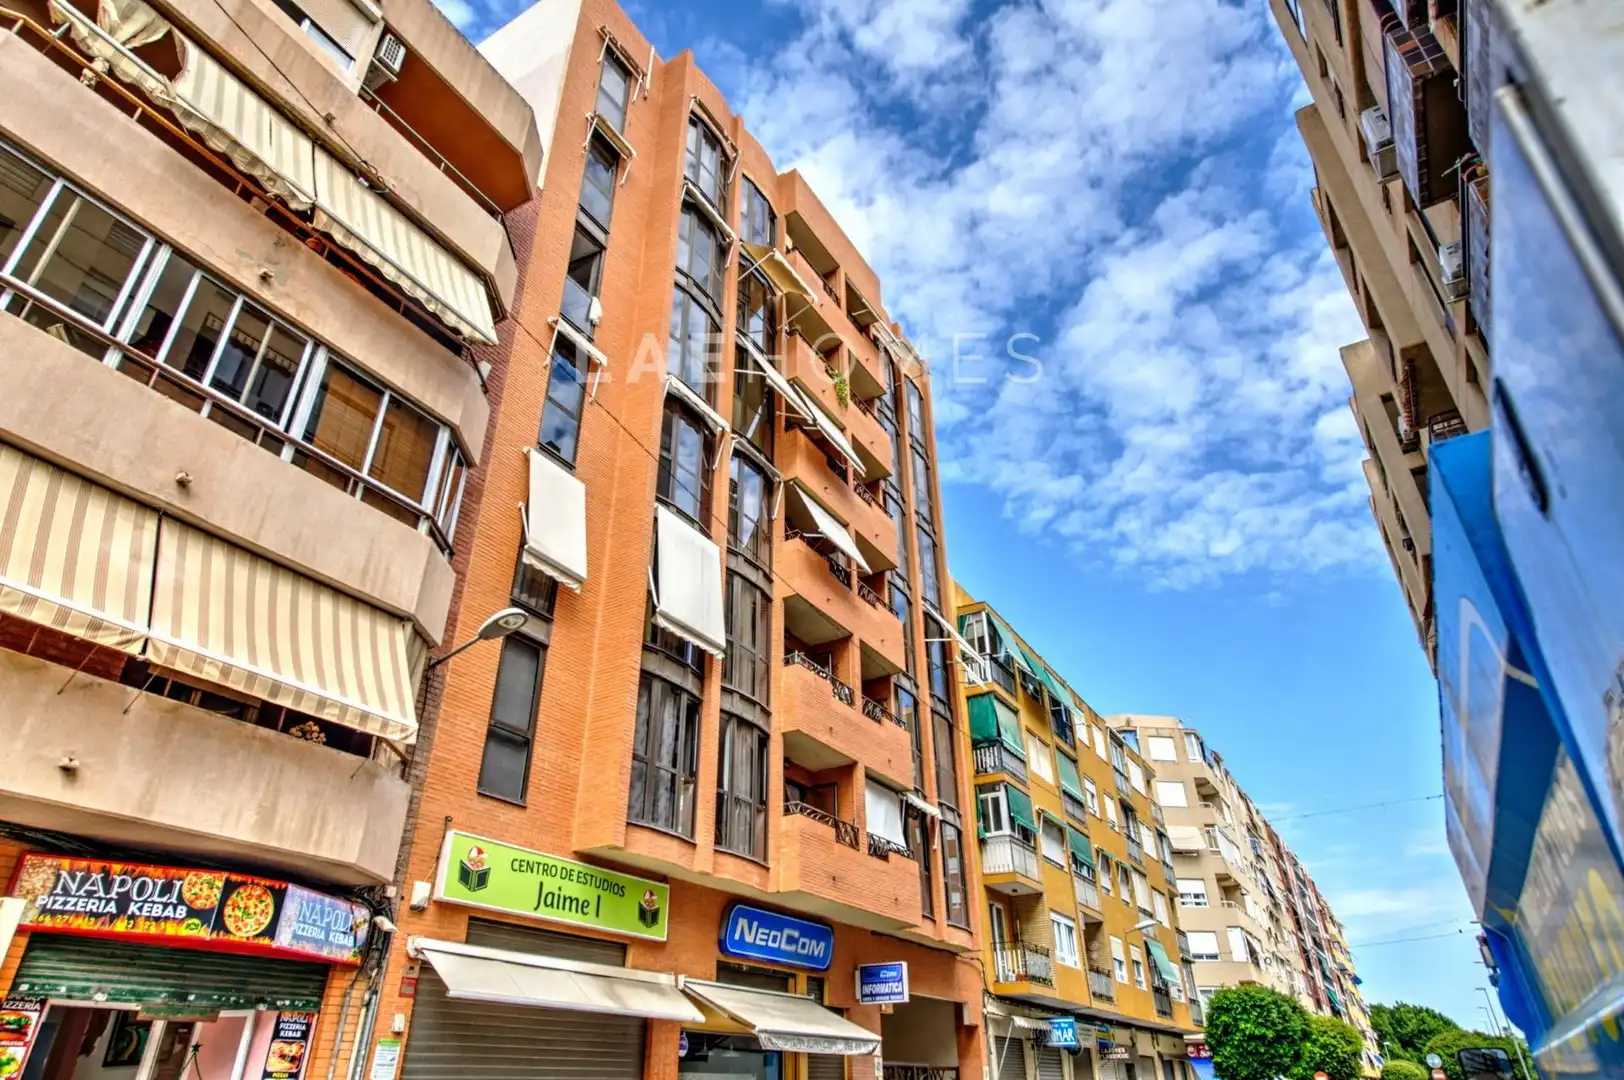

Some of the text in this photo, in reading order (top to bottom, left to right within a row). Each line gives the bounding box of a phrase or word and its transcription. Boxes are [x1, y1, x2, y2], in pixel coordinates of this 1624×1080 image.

[53, 870, 184, 905] NAPOLI
[510, 858, 626, 898] CENTRO DE ESTUDIOS
[35, 895, 188, 919] PIZZERIA KEBAB
[533, 881, 601, 918] Jaime I
[298, 901, 354, 933] NAPOLI
[291, 921, 355, 947] PIZZERIA KEBAB
